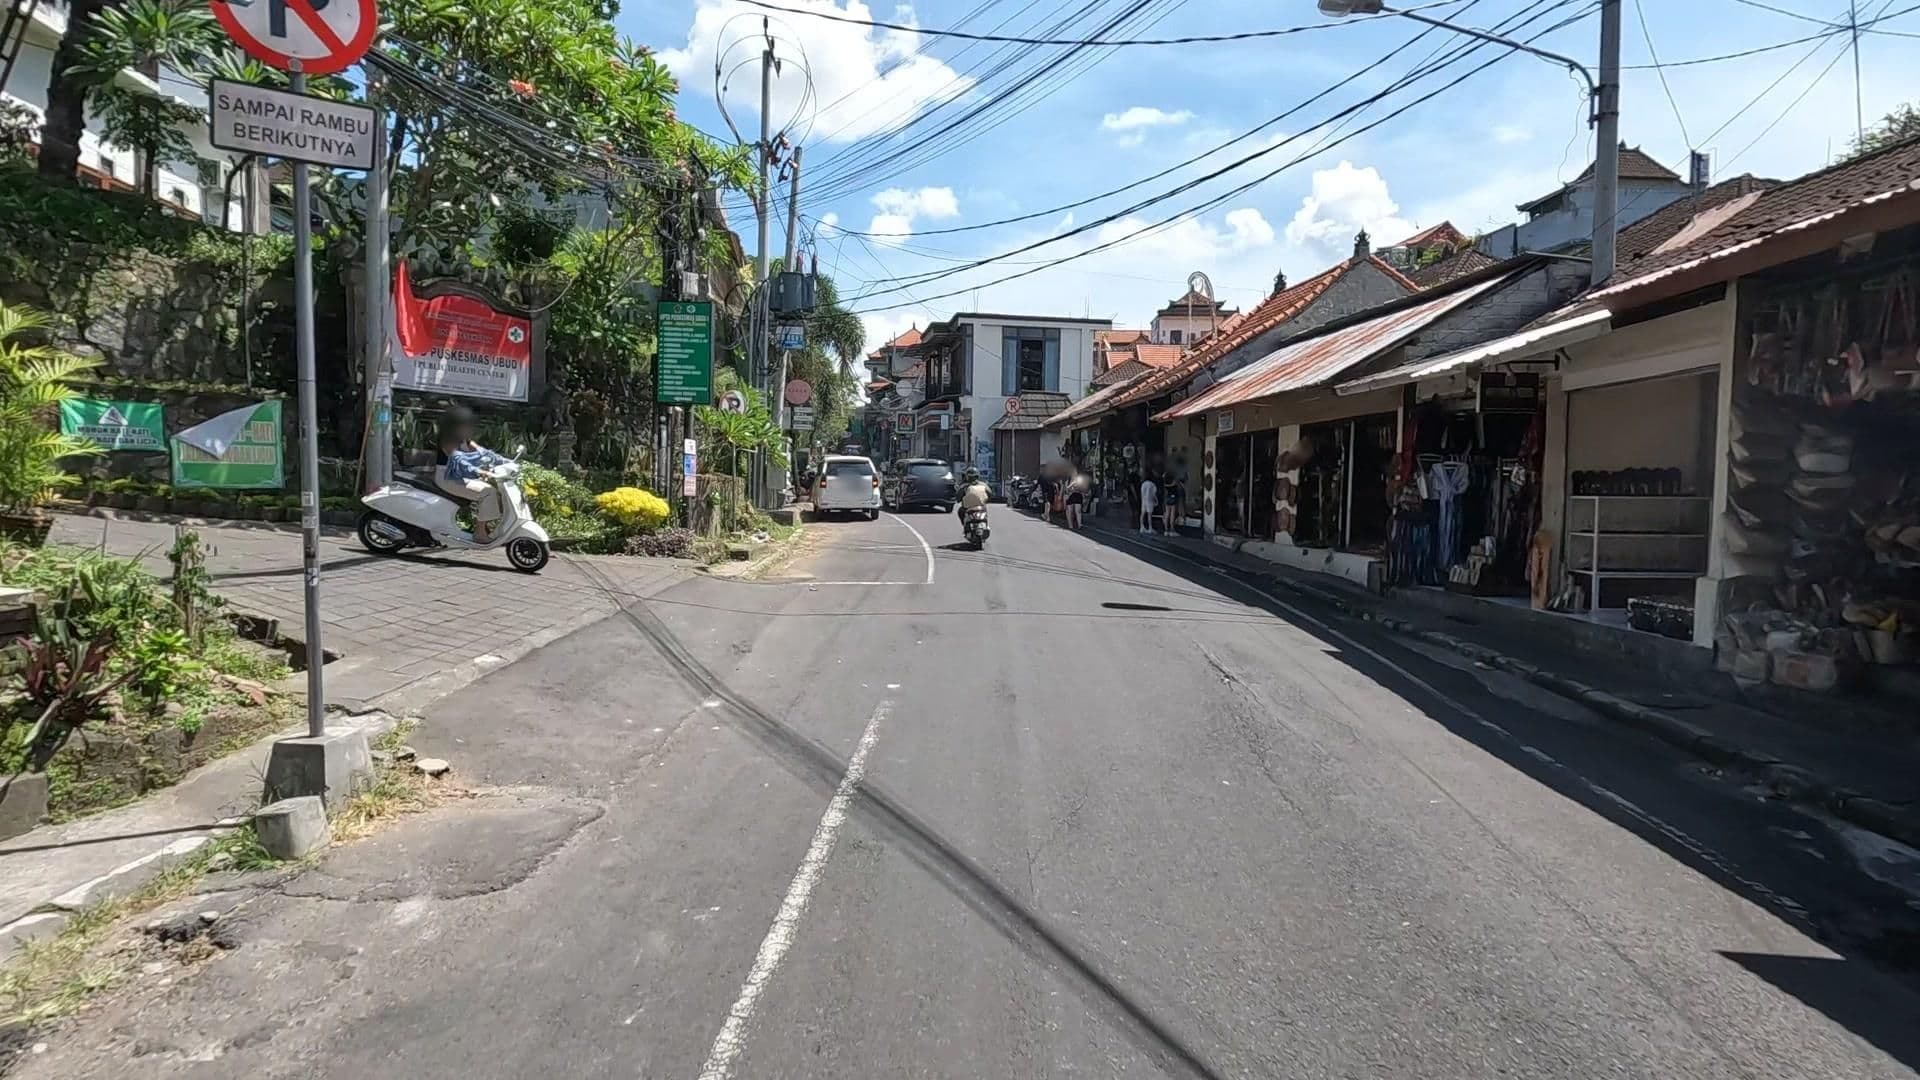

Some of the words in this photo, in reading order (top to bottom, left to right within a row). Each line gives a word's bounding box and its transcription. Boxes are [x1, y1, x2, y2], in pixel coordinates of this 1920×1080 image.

[218, 94, 294, 121] SAMPAI
[301, 109, 369, 135] RAMBU
[233, 122, 356, 157] BERIKUTNYA
[430, 347, 490, 366] PUSKESMAS
[492, 355, 518, 370] UBUD
[448, 365, 476, 376] HEALTH
[477, 369, 505, 379] CENTER
